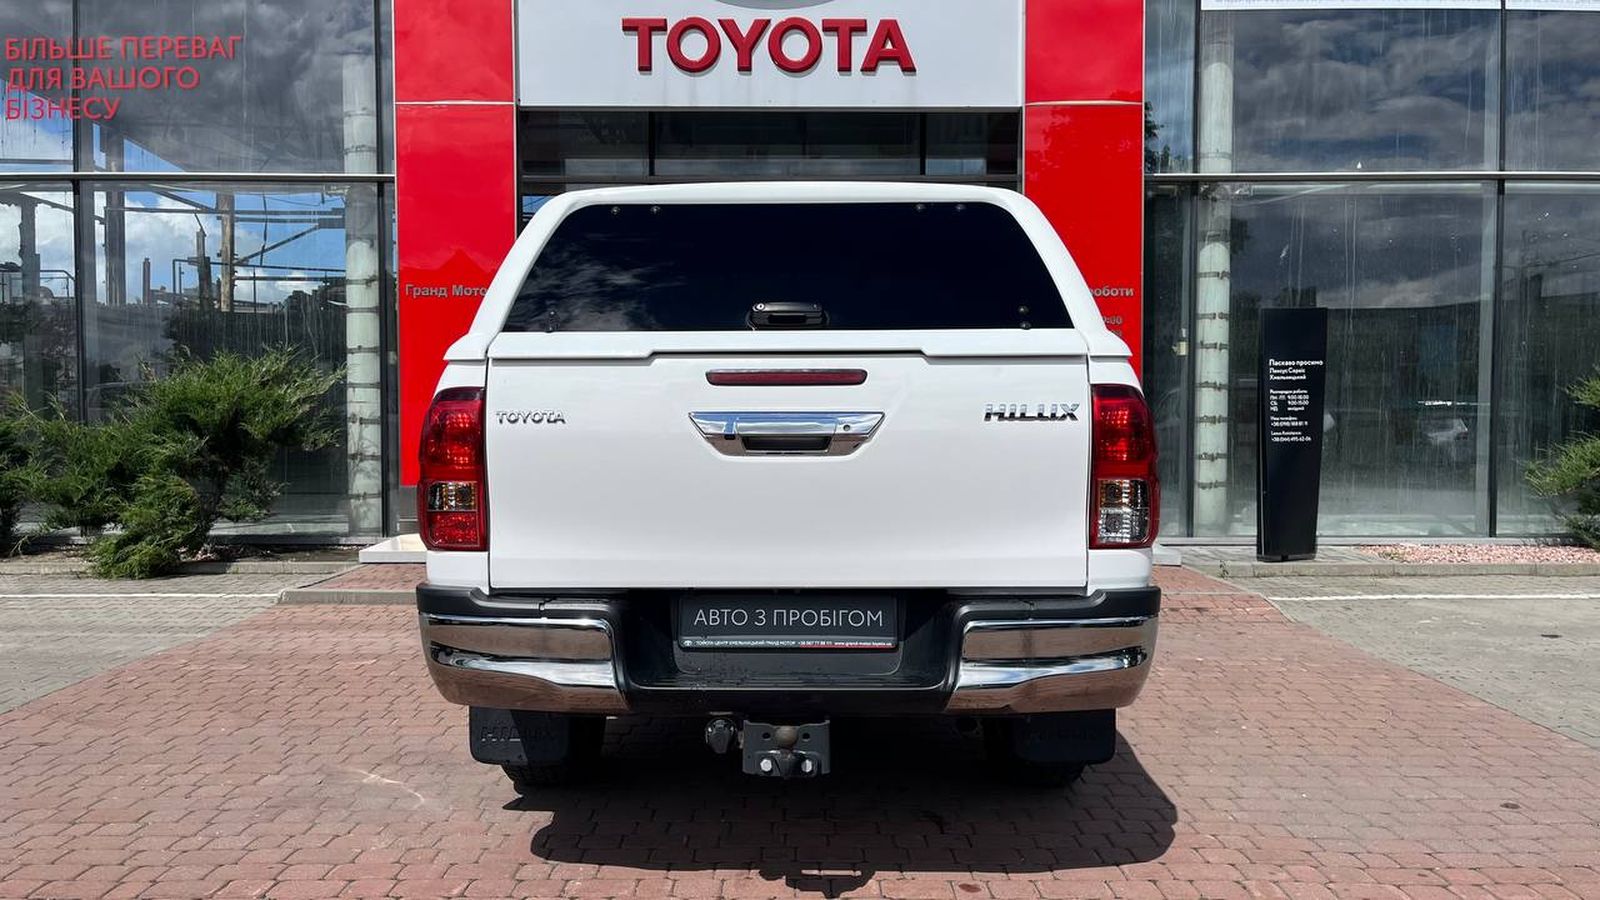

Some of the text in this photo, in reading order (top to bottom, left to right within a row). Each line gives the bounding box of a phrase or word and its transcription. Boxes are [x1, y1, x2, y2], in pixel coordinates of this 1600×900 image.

[5, 35, 242, 60] БІЛЬШЕ ПЕРЕВАГ
[622, 16, 916, 74] TOYOTA
[8, 65, 200, 92] ДЛЯ ВАШОГО
[5, 97, 122, 121] БІЗНЕСУ
[405, 283, 448, 298] Гранд
[1091, 284, 1134, 297] оботи
[495, 410, 567, 424] TOYOTA
[984, 403, 1080, 421] HILUX
[694, 609, 883, 627] АВТО З ПРОБІГОМ
